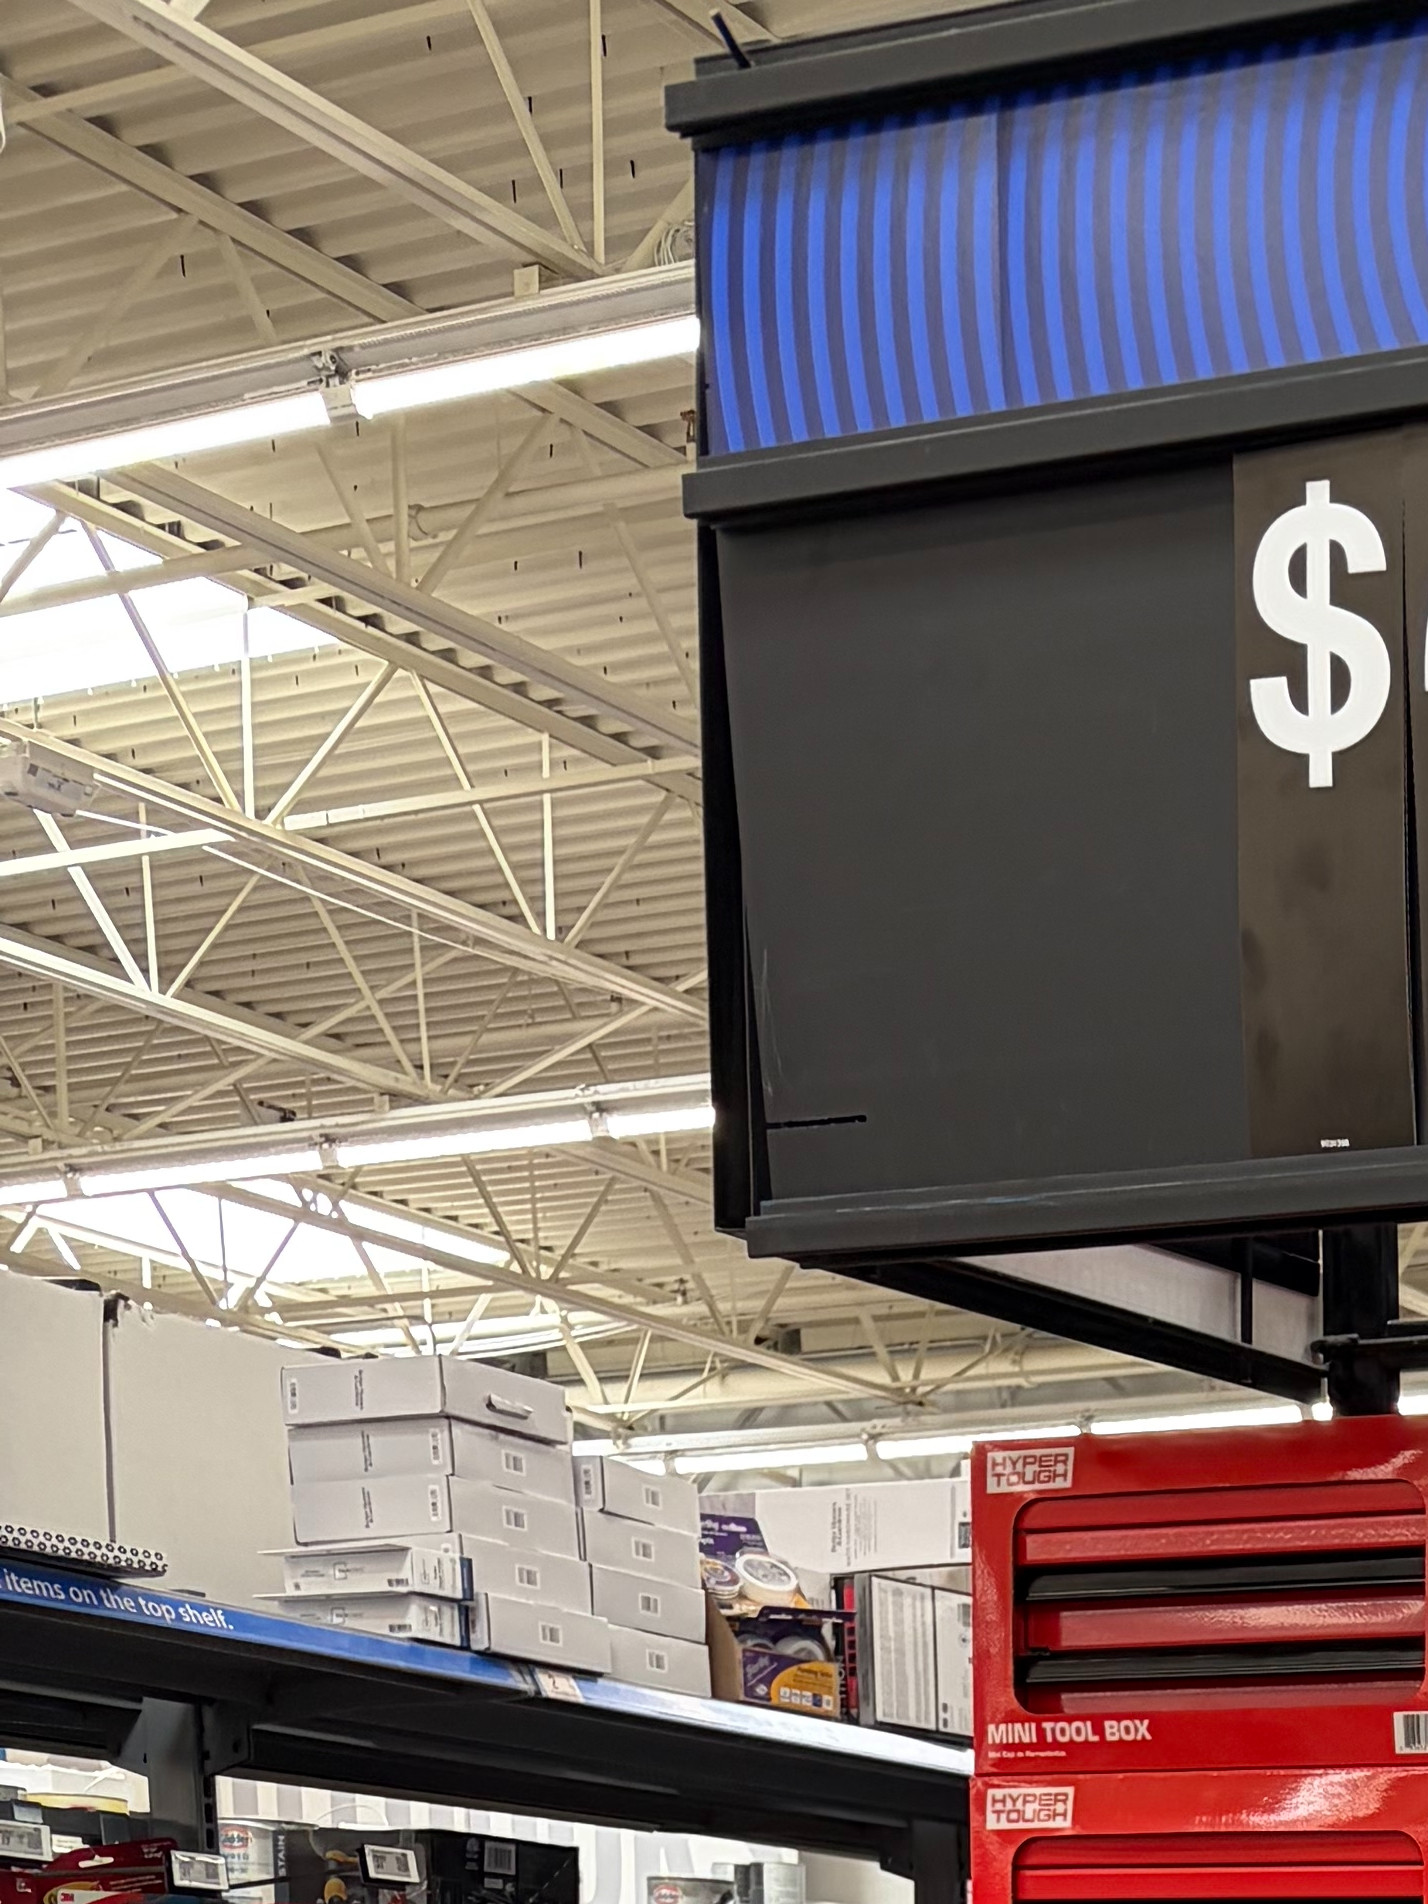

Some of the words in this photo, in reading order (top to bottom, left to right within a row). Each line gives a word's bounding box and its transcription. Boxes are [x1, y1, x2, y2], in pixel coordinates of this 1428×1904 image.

[3, 1568, 65, 1601] items
[69, 1585, 98, 1606] on
[100, 1586, 136, 1613] the
[138, 1598, 176, 1624] top
[178, 1603, 235, 1630] shelf.
